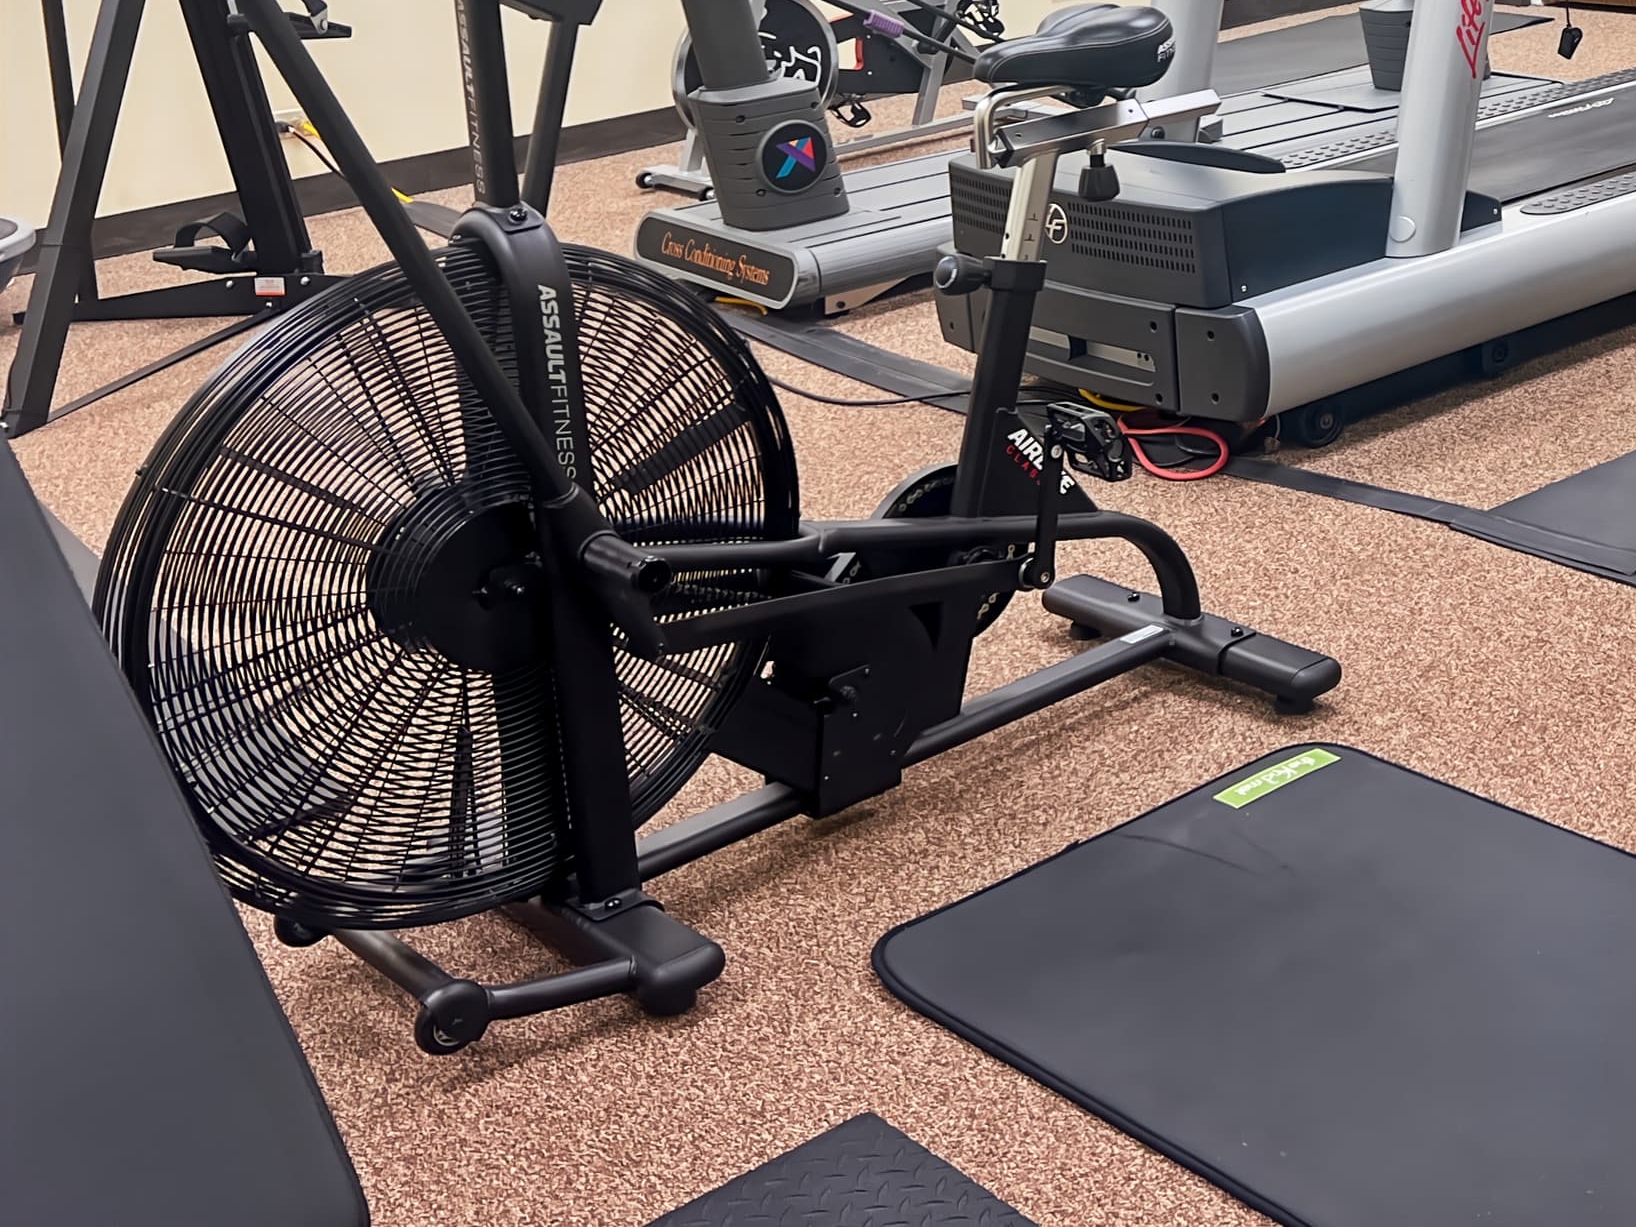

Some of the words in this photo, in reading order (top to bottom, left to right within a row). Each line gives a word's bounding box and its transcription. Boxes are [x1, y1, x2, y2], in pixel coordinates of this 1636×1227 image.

[661, 231, 685, 259] Cross
[684, 238, 736, 280] Conditioning
[735, 254, 771, 286] Systems
[1007, 428, 1076, 495] AIRE
